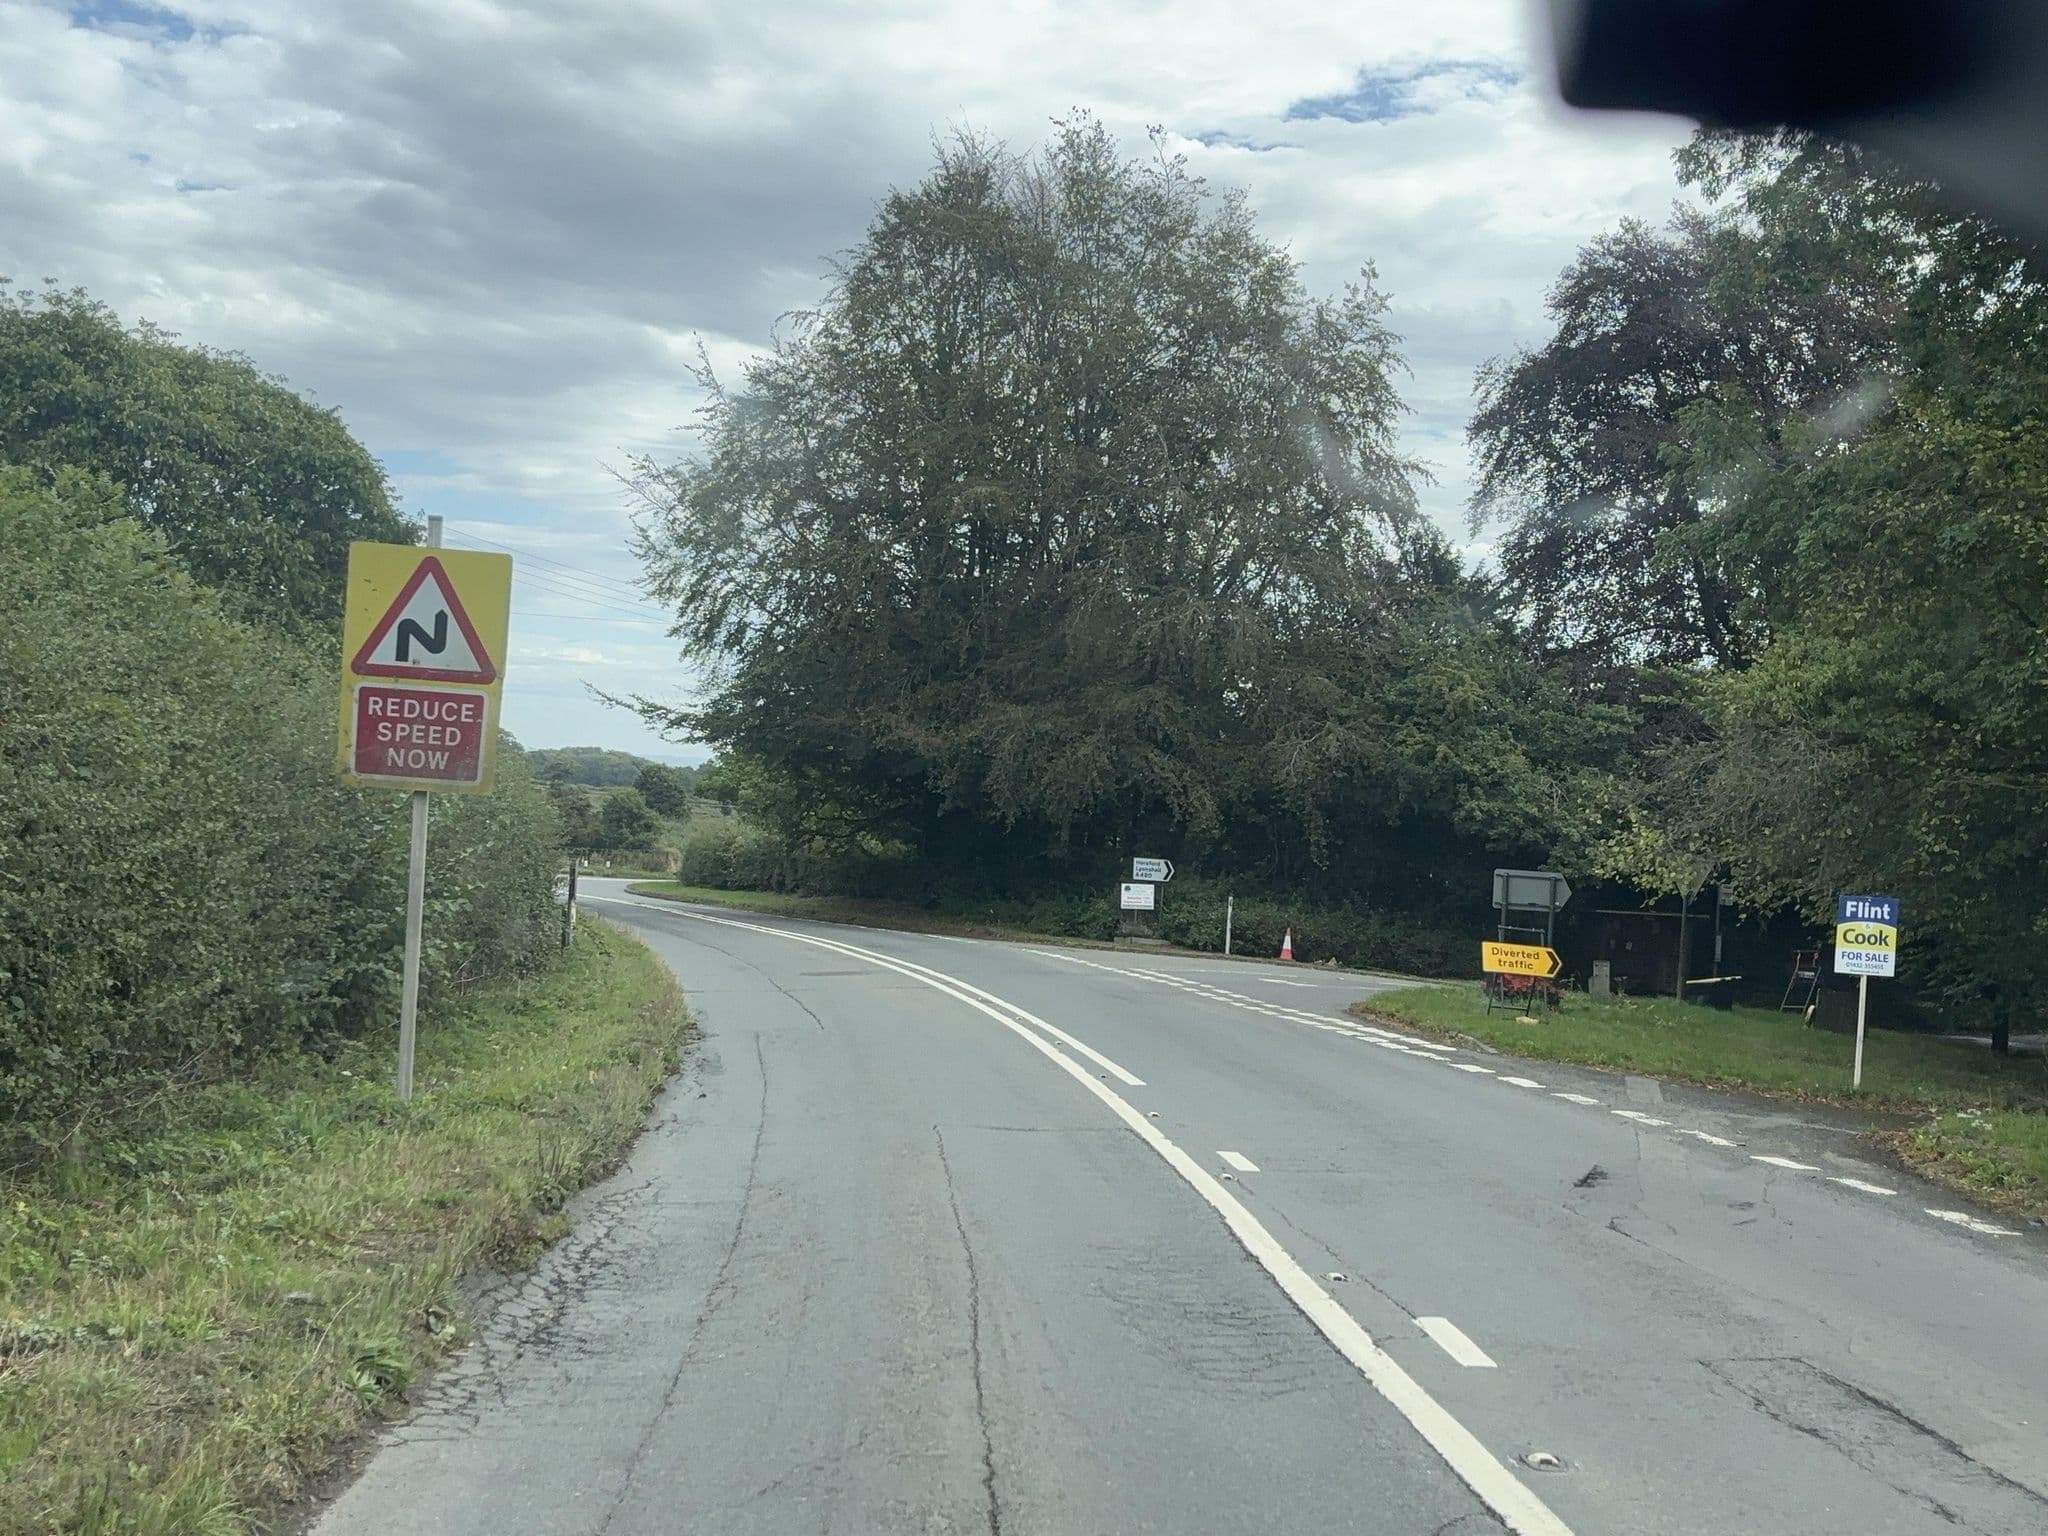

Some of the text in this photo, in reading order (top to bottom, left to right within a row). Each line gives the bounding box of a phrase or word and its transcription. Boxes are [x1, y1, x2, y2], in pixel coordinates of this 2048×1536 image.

[368, 696, 475, 722] REDUCE
[377, 722, 462, 746] SPEED
[387, 748, 449, 769] NOW
[1845, 901, 1890, 920] Flint
[1843, 928, 1889, 946] Cook
[1491, 947, 1540, 959] Diverted
[1841, 951, 1889, 963] FOR SALE
[1498, 958, 1534, 970] traffic
